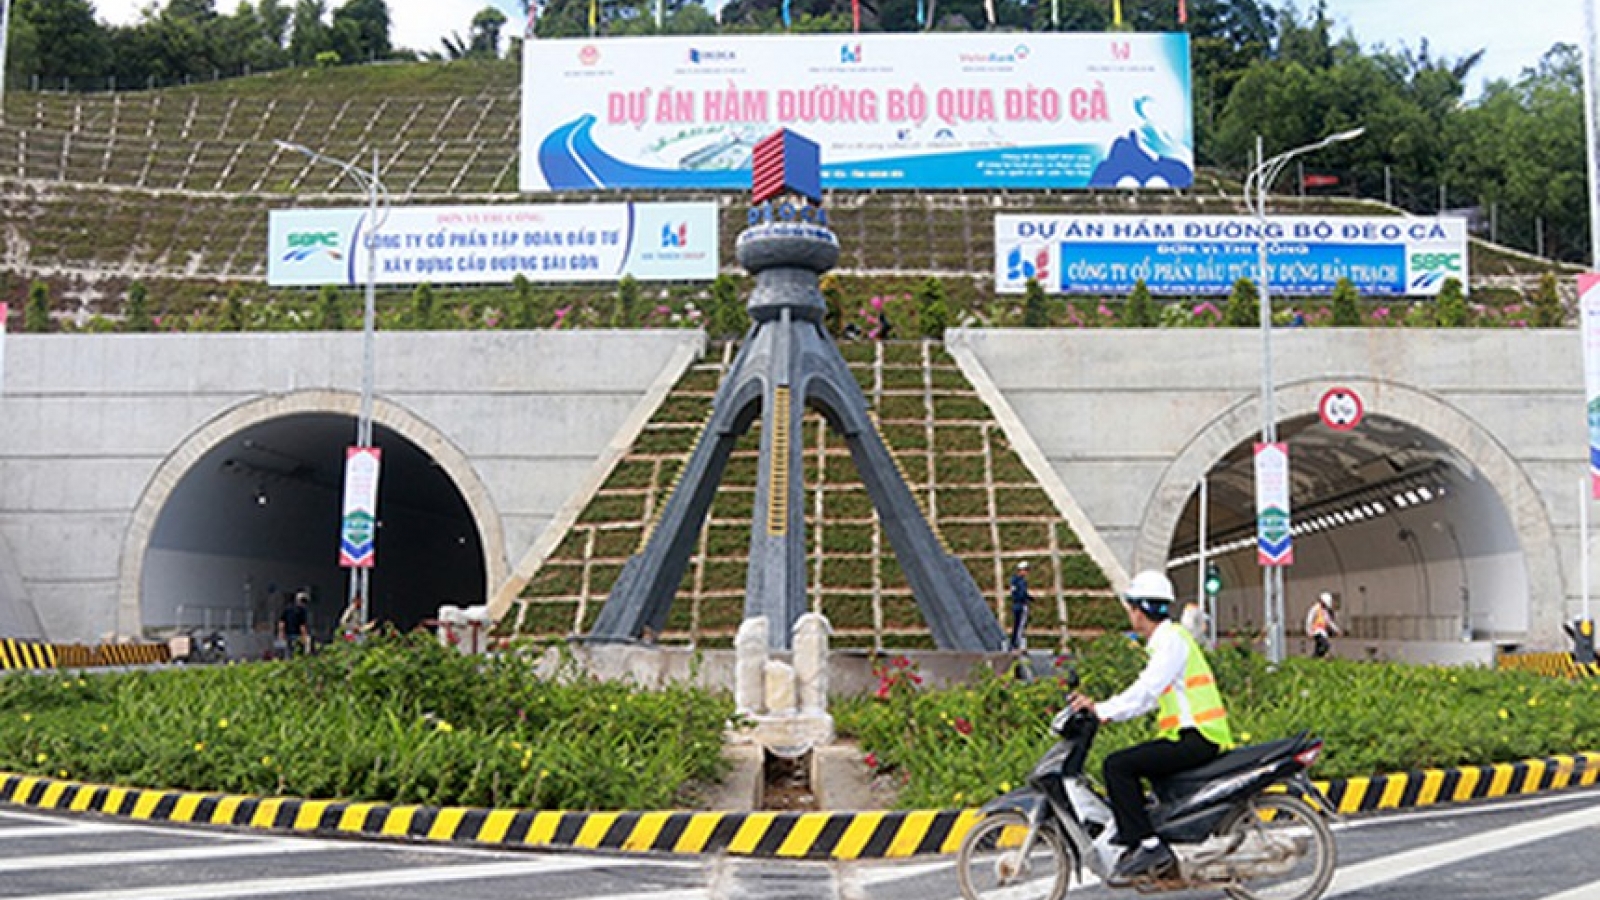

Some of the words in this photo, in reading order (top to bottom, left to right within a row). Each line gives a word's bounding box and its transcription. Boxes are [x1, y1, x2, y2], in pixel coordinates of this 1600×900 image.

[608, 86, 652, 130] DỰ
[655, 84, 694, 124] ÁN
[777, 84, 877, 124] ĐƯỜNG
[887, 83, 927, 128] BỘ
[936, 87, 996, 125] QUA
[1004, 83, 1059, 122] ĐÈO
[405, 234, 423, 248] TY
[1018, 220, 1058, 239] DỰ
[1066, 219, 1104, 238] ÁN
[1294, 220, 1333, 241] BỘ
[1342, 220, 1401, 239] ĐÈO
